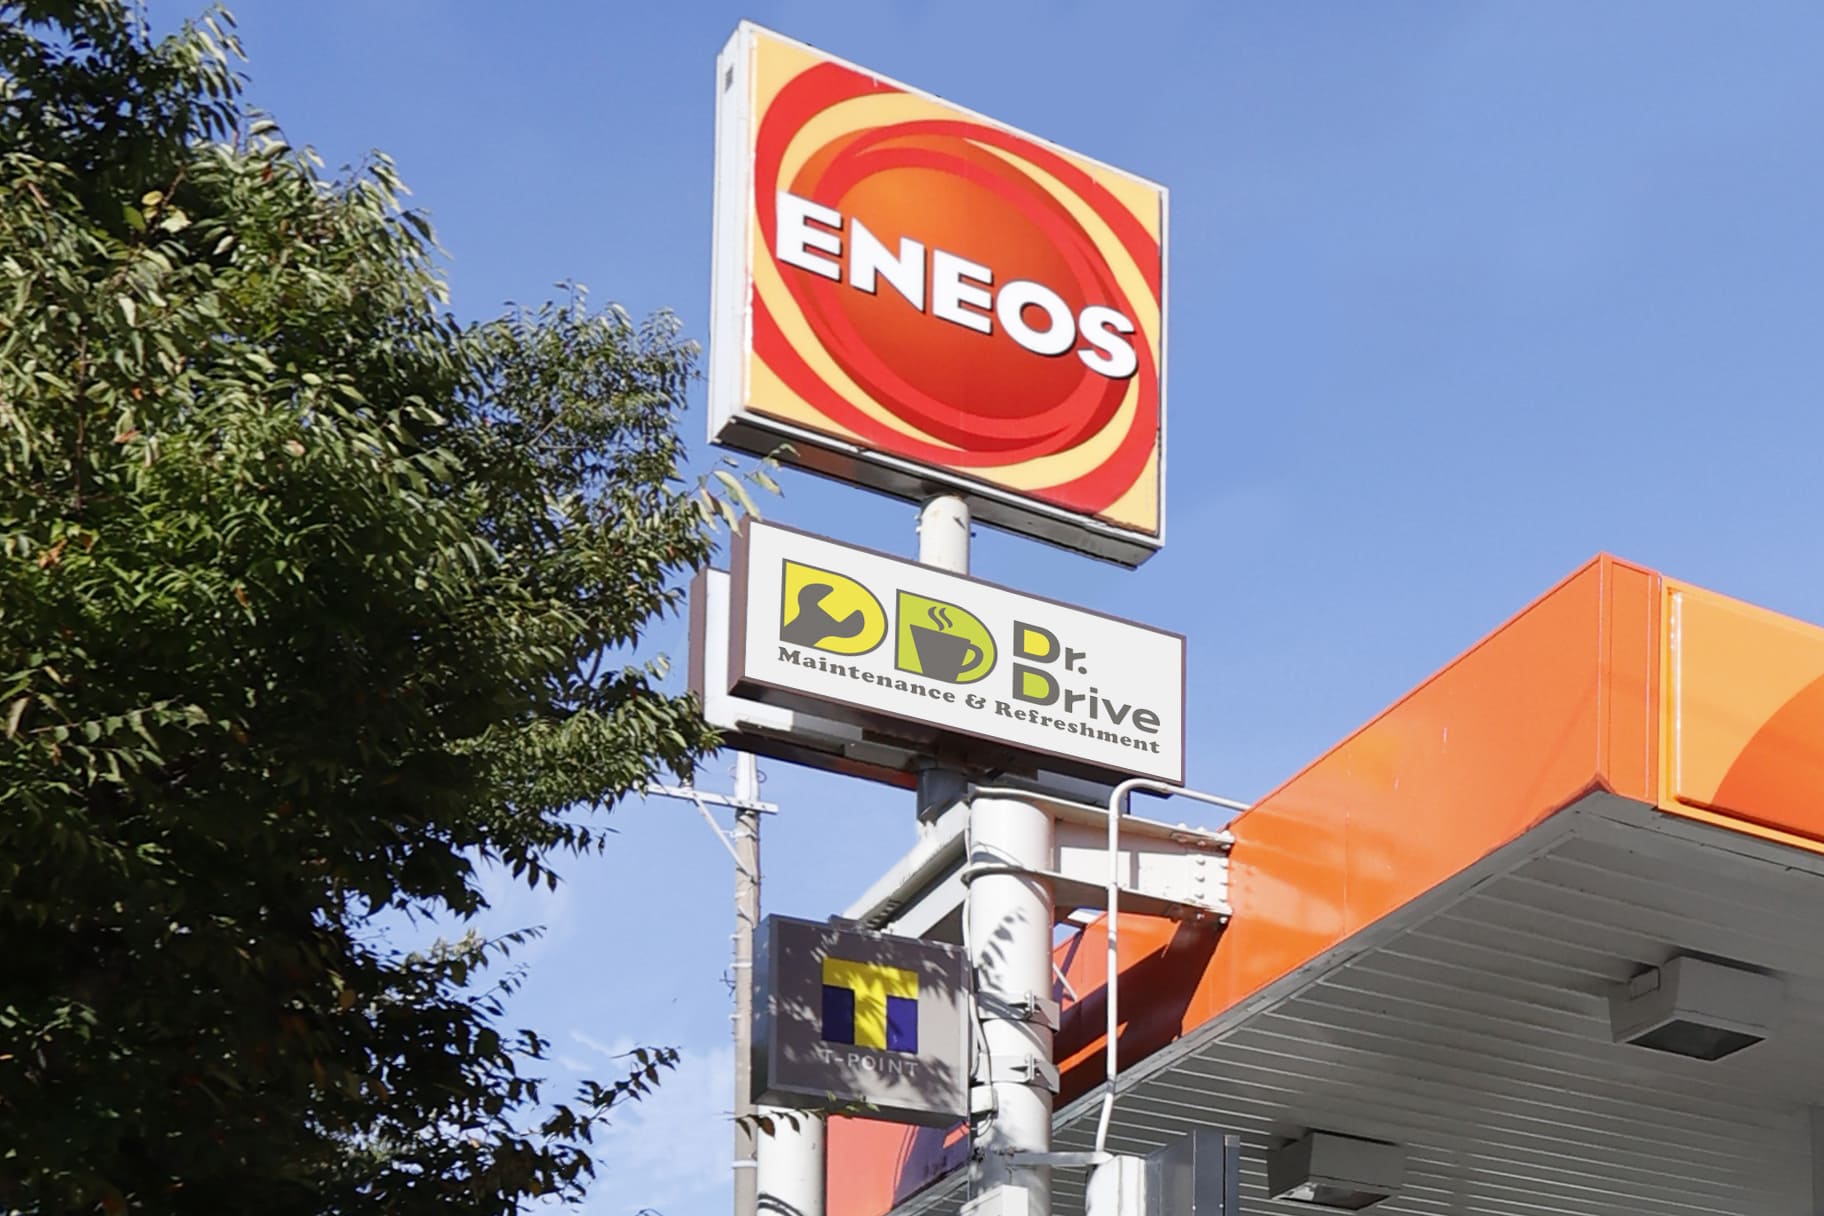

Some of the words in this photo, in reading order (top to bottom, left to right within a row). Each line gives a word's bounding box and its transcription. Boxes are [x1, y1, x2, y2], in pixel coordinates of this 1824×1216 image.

[777, 190, 1137, 379] ENEOS
[1012, 619, 1088, 676] Dr.
[778, 646, 956, 705] Maintenance
[965, 691, 986, 711] &
[994, 699, 1161, 755] Refreshment
[1011, 661, 1161, 735] Drive
[820, 1047, 919, 1077] T-POINT
